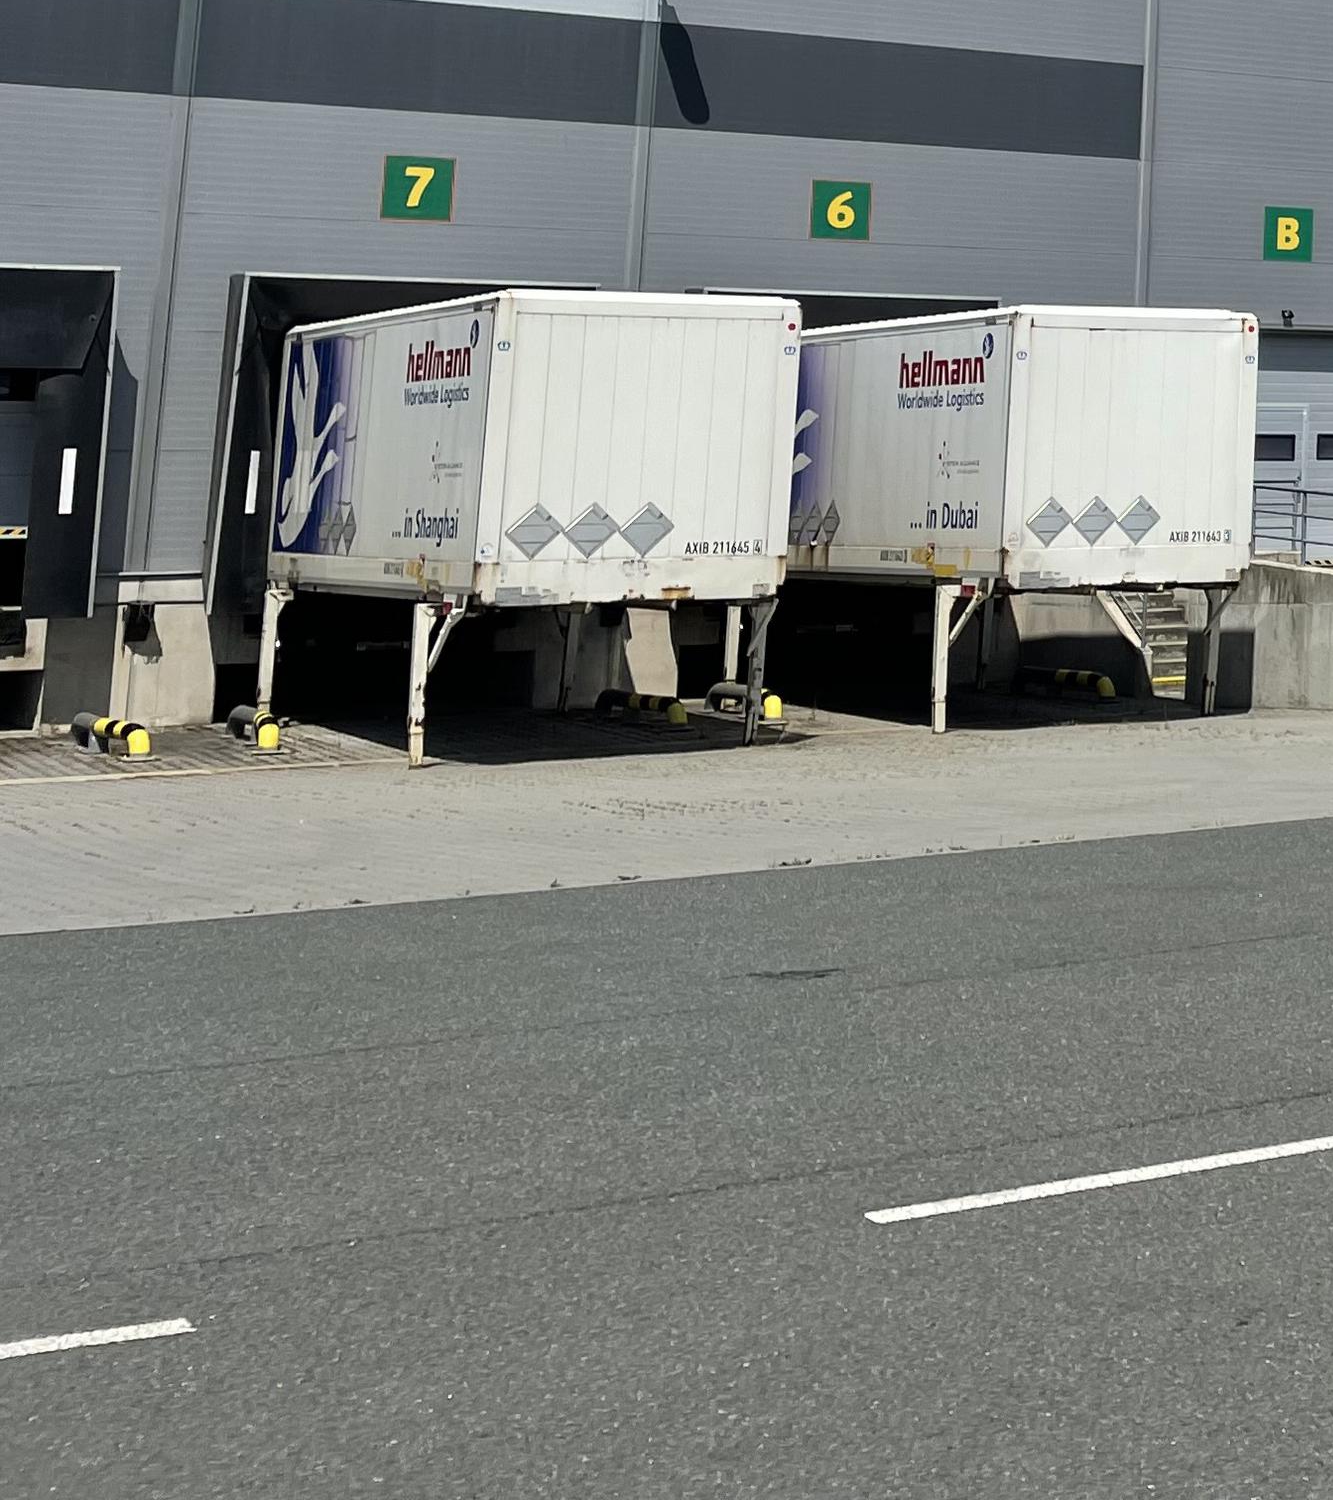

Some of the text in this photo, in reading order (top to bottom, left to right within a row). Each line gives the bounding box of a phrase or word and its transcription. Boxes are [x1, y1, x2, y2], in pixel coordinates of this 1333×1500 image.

[404, 166, 435, 208] 7
[826, 190, 856, 229] 6
[1276, 216, 1301, 251] B
[406, 340, 471, 383] hellmann
[898, 350, 985, 389] hellmann
[403, 381, 470, 409] Worldwide Logistics
[897, 388, 985, 412] Worldwide Logistics
[404, 507, 414, 538] in
[415, 507, 459, 547] Shanghai
[926, 500, 938, 530] in
[941, 500, 979, 530] Dubai
[684, 540, 762, 555] AXIB 211645 4
[1169, 531, 1190, 542] AXIB
[1192, 530, 1221, 542] 211643
